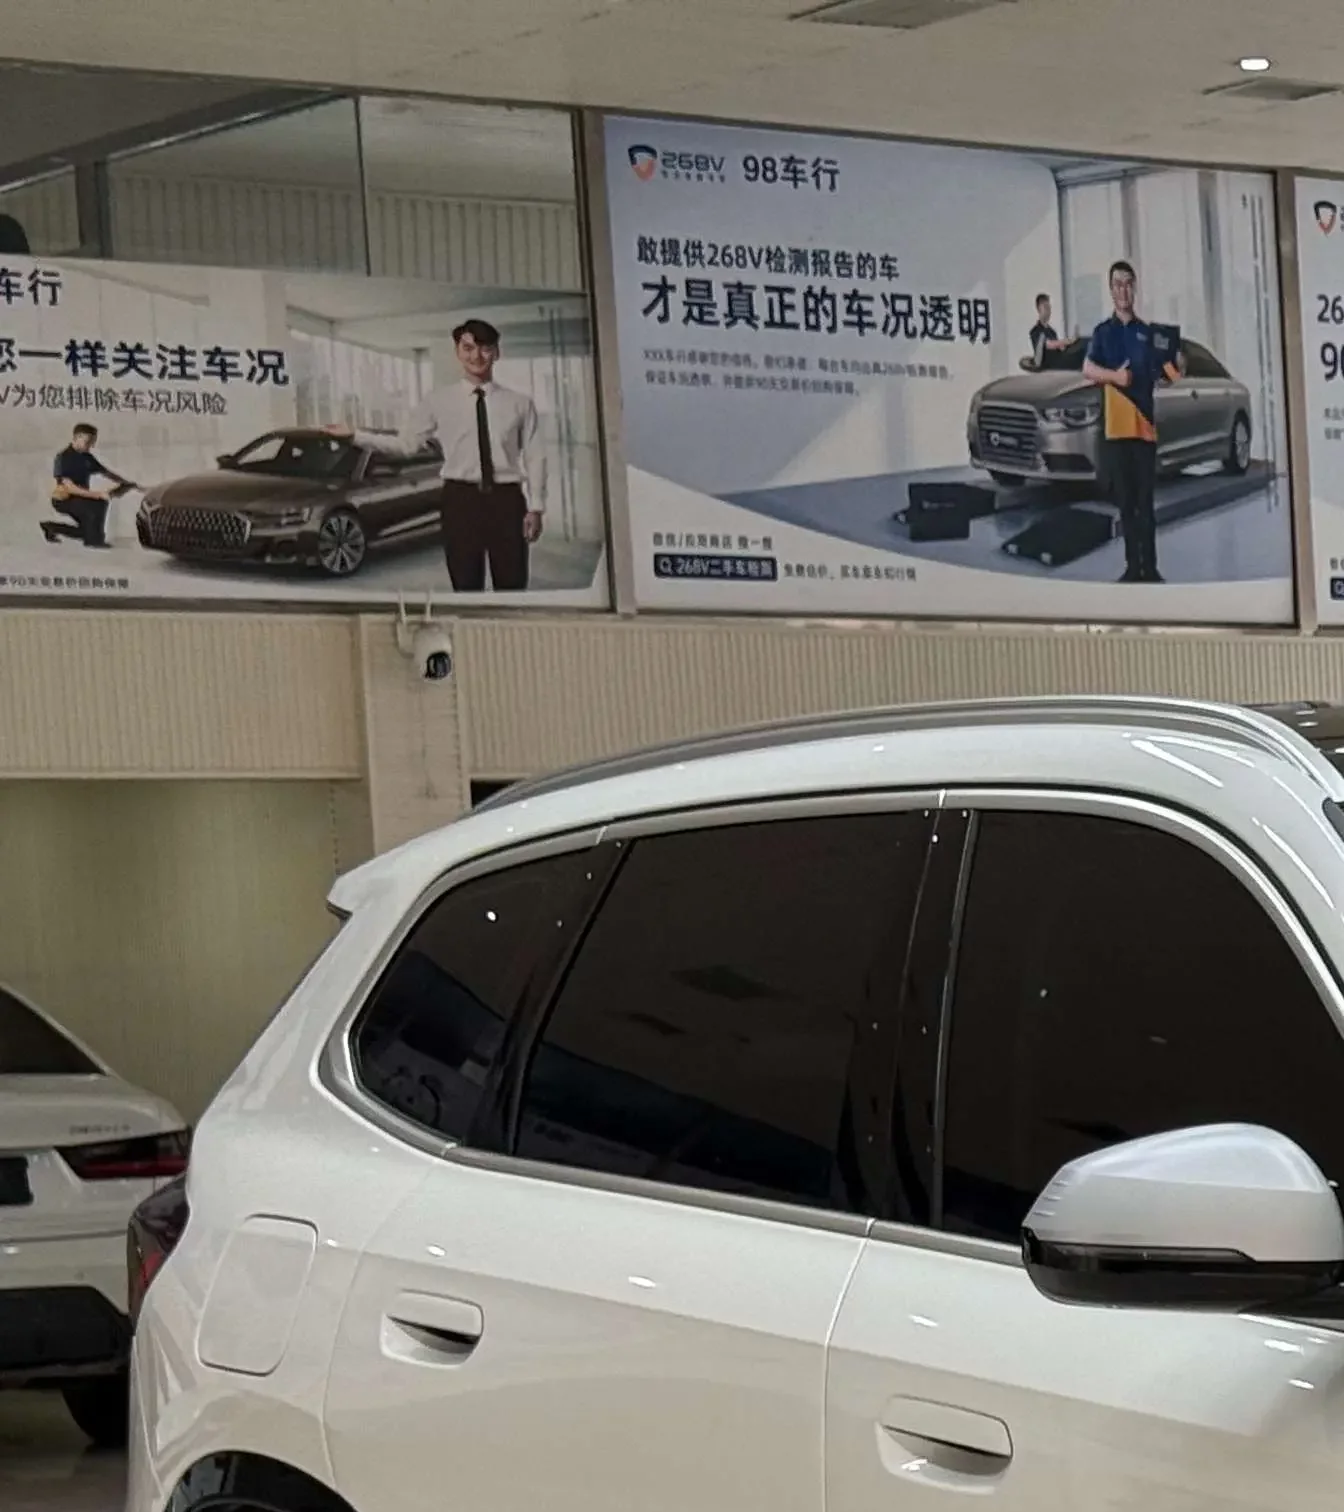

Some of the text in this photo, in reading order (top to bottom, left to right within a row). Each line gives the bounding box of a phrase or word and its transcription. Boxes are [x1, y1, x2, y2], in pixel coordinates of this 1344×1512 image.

[742, 154, 841, 192] 98车行
[636, 234, 901, 282] 敢提供268V检测报告的车
[641, 276, 992, 346] 才是真正的车况透明
